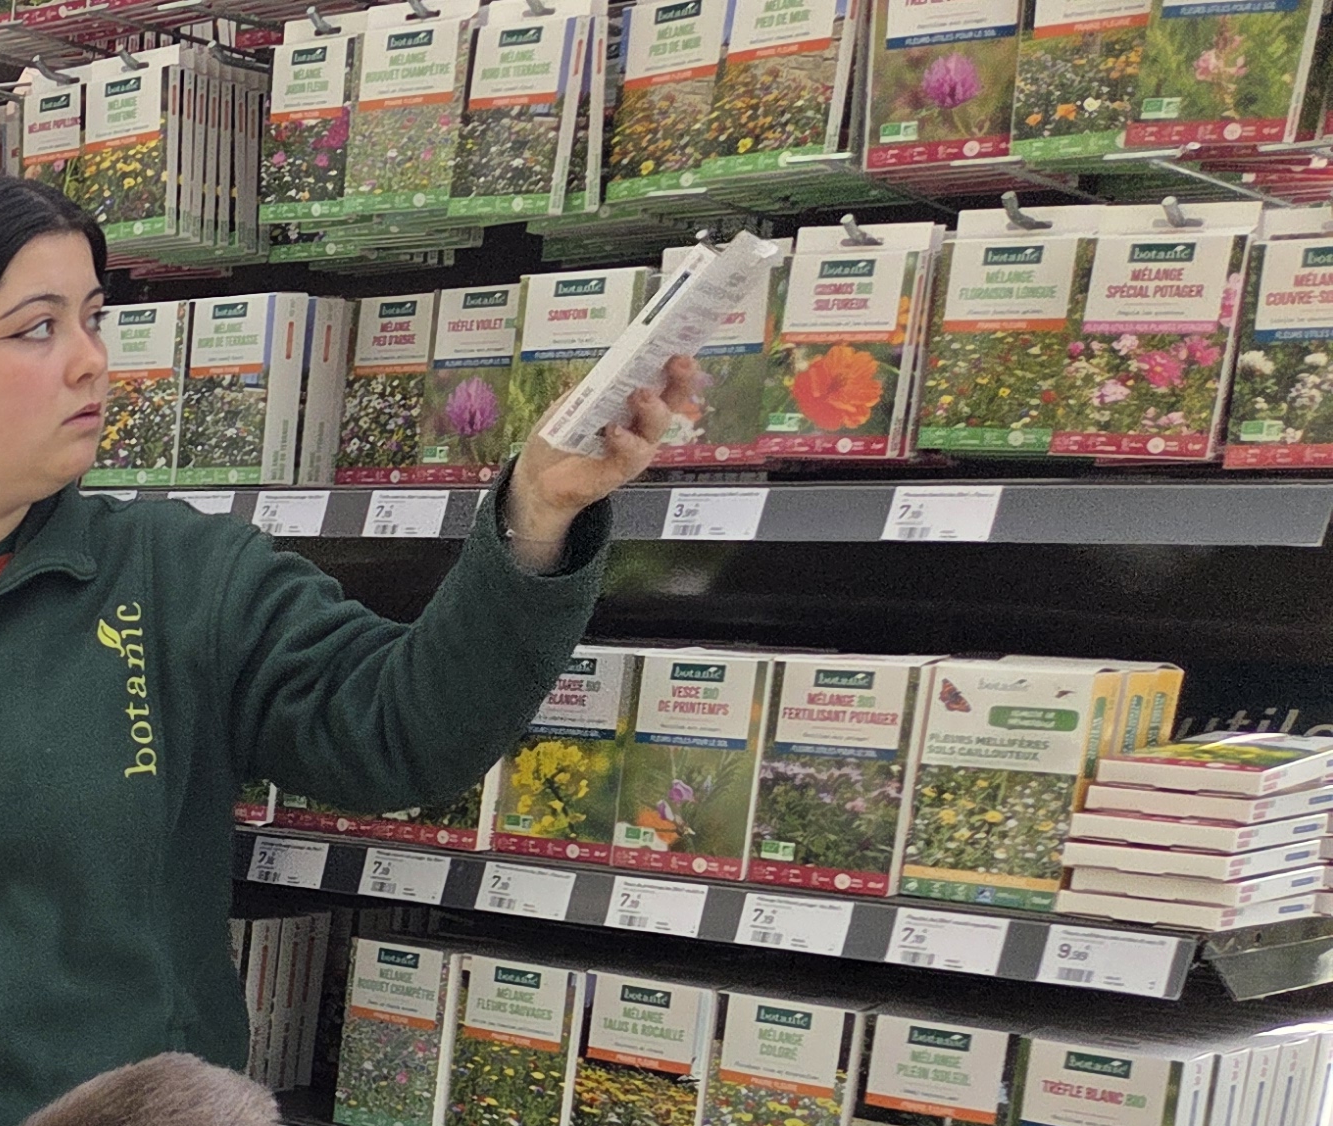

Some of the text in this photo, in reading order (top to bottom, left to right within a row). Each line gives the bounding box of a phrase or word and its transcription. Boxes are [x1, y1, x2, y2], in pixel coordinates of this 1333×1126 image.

[1132, 245, 1191, 261] botanic
[986, 269, 1034, 284] MÉLANGE
[1131, 267, 1183, 282] MÉLANGE
[1106, 282, 1204, 299] SPÉCIAL POTAGER
[448, 318, 503, 333] TRÈFLE VIOLET
[675, 666, 723, 680] botanic
[818, 673, 870, 687] botanic
[116, 601, 157, 778] botanic
[672, 686, 701, 698] VESCE
[807, 691, 854, 708] MÉLANGE
[658, 701, 729, 716] DE PRINTEMPS
[783, 708, 898, 726] FERTILISANT POTAGER
[497, 987, 535, 1002] MÉLANGE
[623, 987, 668, 1006] botanic
[477, 999, 553, 1021] FLEURS SAUVAGES
[623, 1007, 664, 1024] MÉLANGE
[760, 1009, 809, 1027] botanic
[604, 1017, 629, 1033] TALUS
[641, 1025, 684, 1042] ROCAILLE
[758, 1028, 804, 1045] MÉLANGE
[1042, 1079, 1123, 1104] TRÈFLE BLANC
